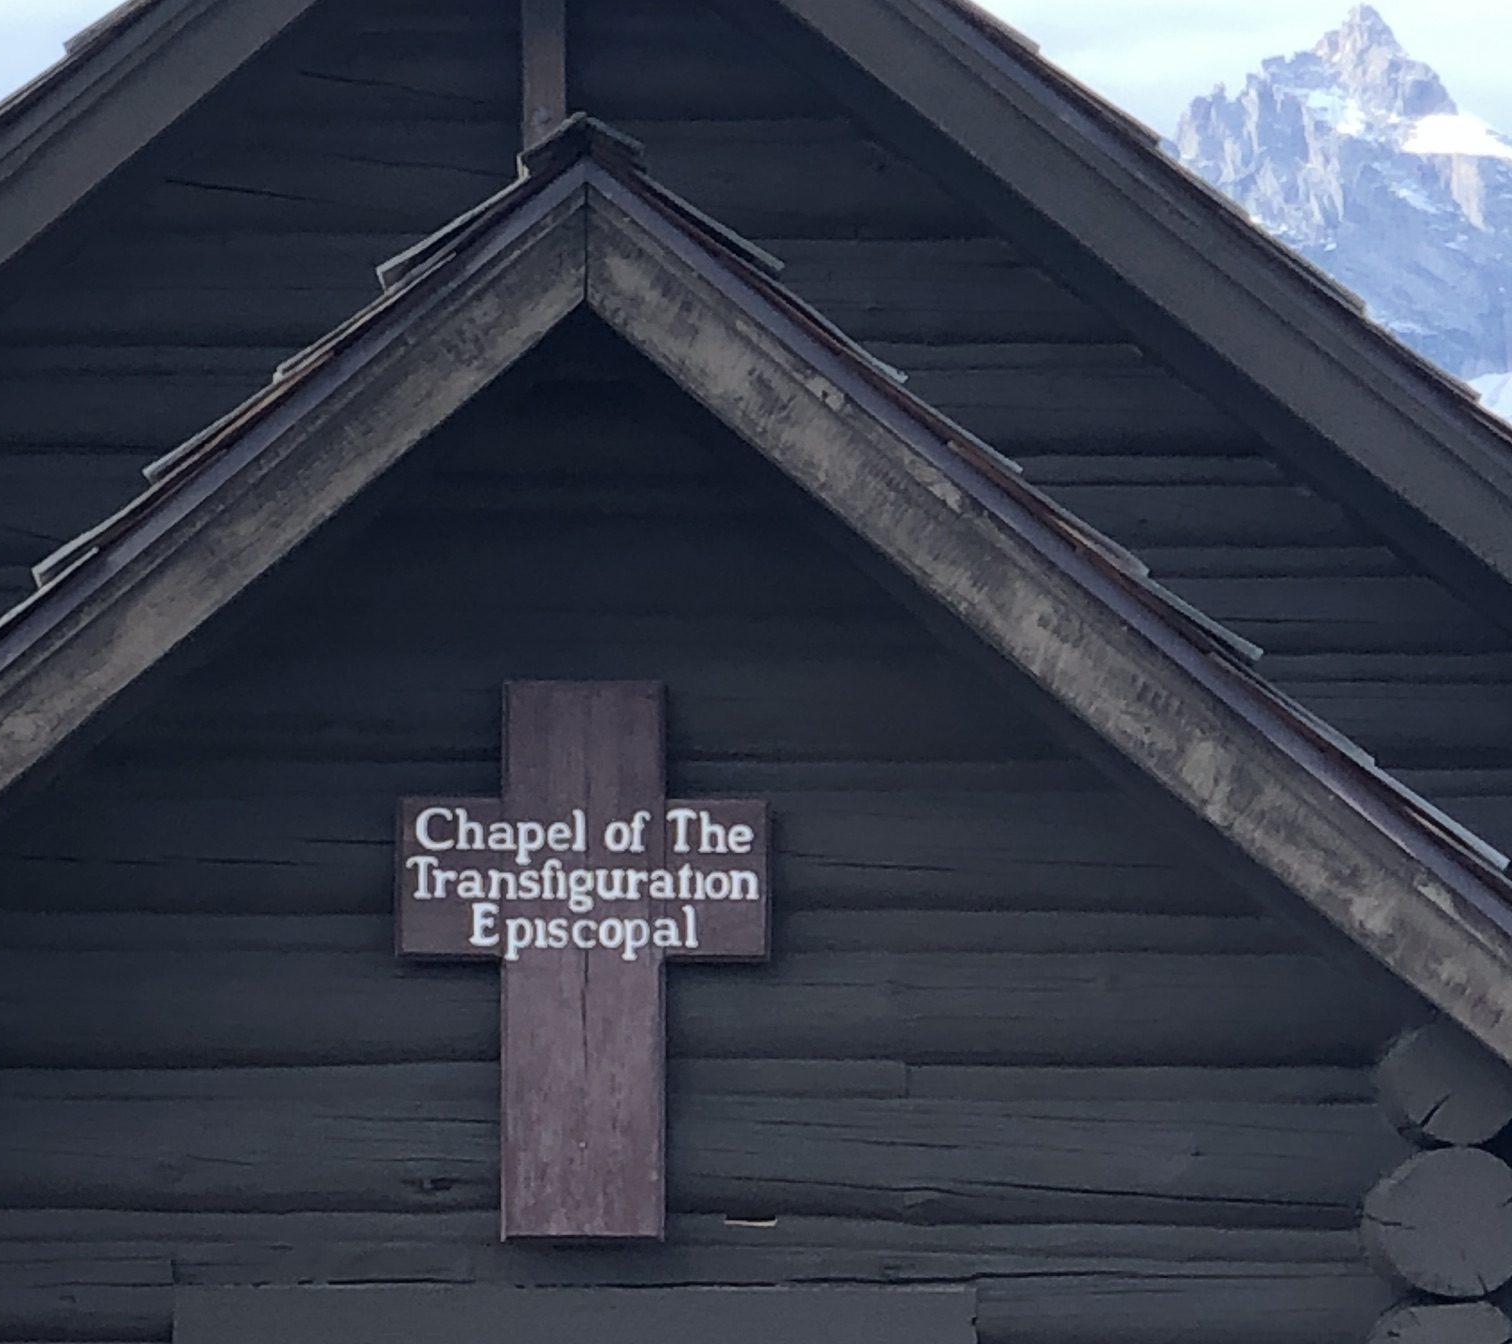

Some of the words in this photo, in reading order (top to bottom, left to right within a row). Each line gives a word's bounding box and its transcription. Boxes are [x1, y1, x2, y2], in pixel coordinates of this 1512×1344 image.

[414, 806, 587, 865] Chapel
[604, 809, 652, 853] of
[665, 807, 755, 854] The
[405, 855, 760, 913] Transfiguration
[468, 902, 700, 961] Episcopal
